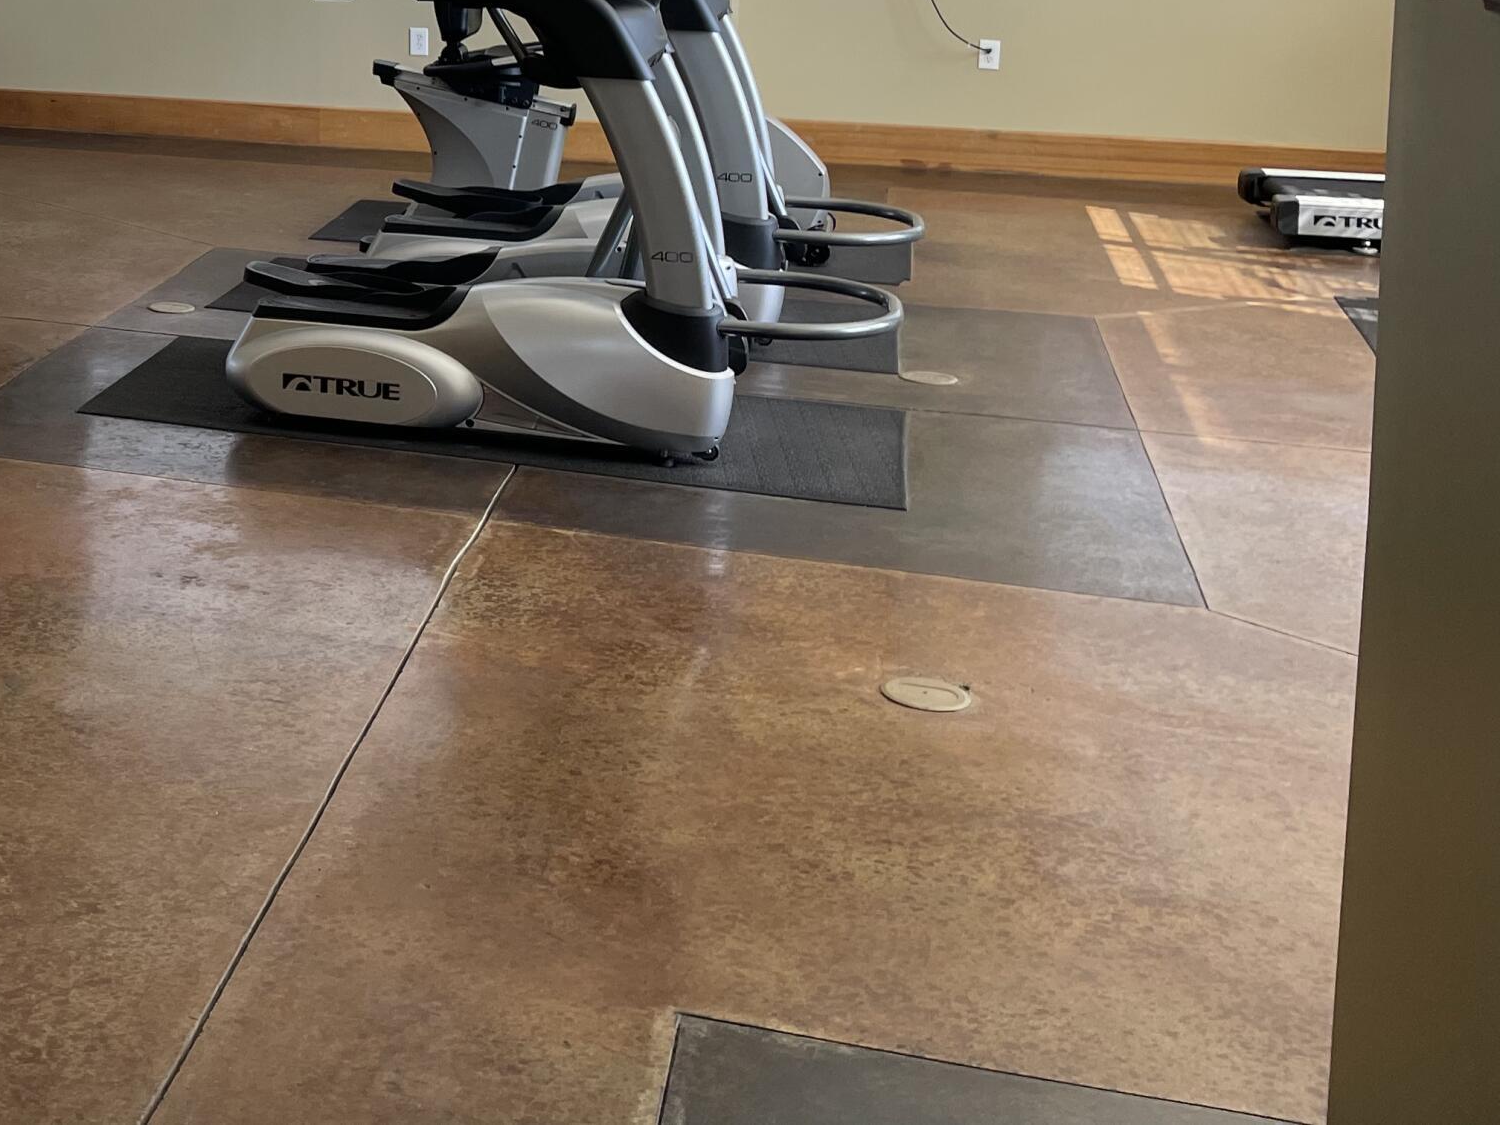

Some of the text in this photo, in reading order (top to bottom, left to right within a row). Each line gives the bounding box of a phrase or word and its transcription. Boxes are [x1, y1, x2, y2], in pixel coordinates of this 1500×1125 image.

[531, 119, 557, 130] 400
[717, 172, 752, 182] 400
[651, 251, 693, 263] 400
[312, 376, 400, 401] TRUE
